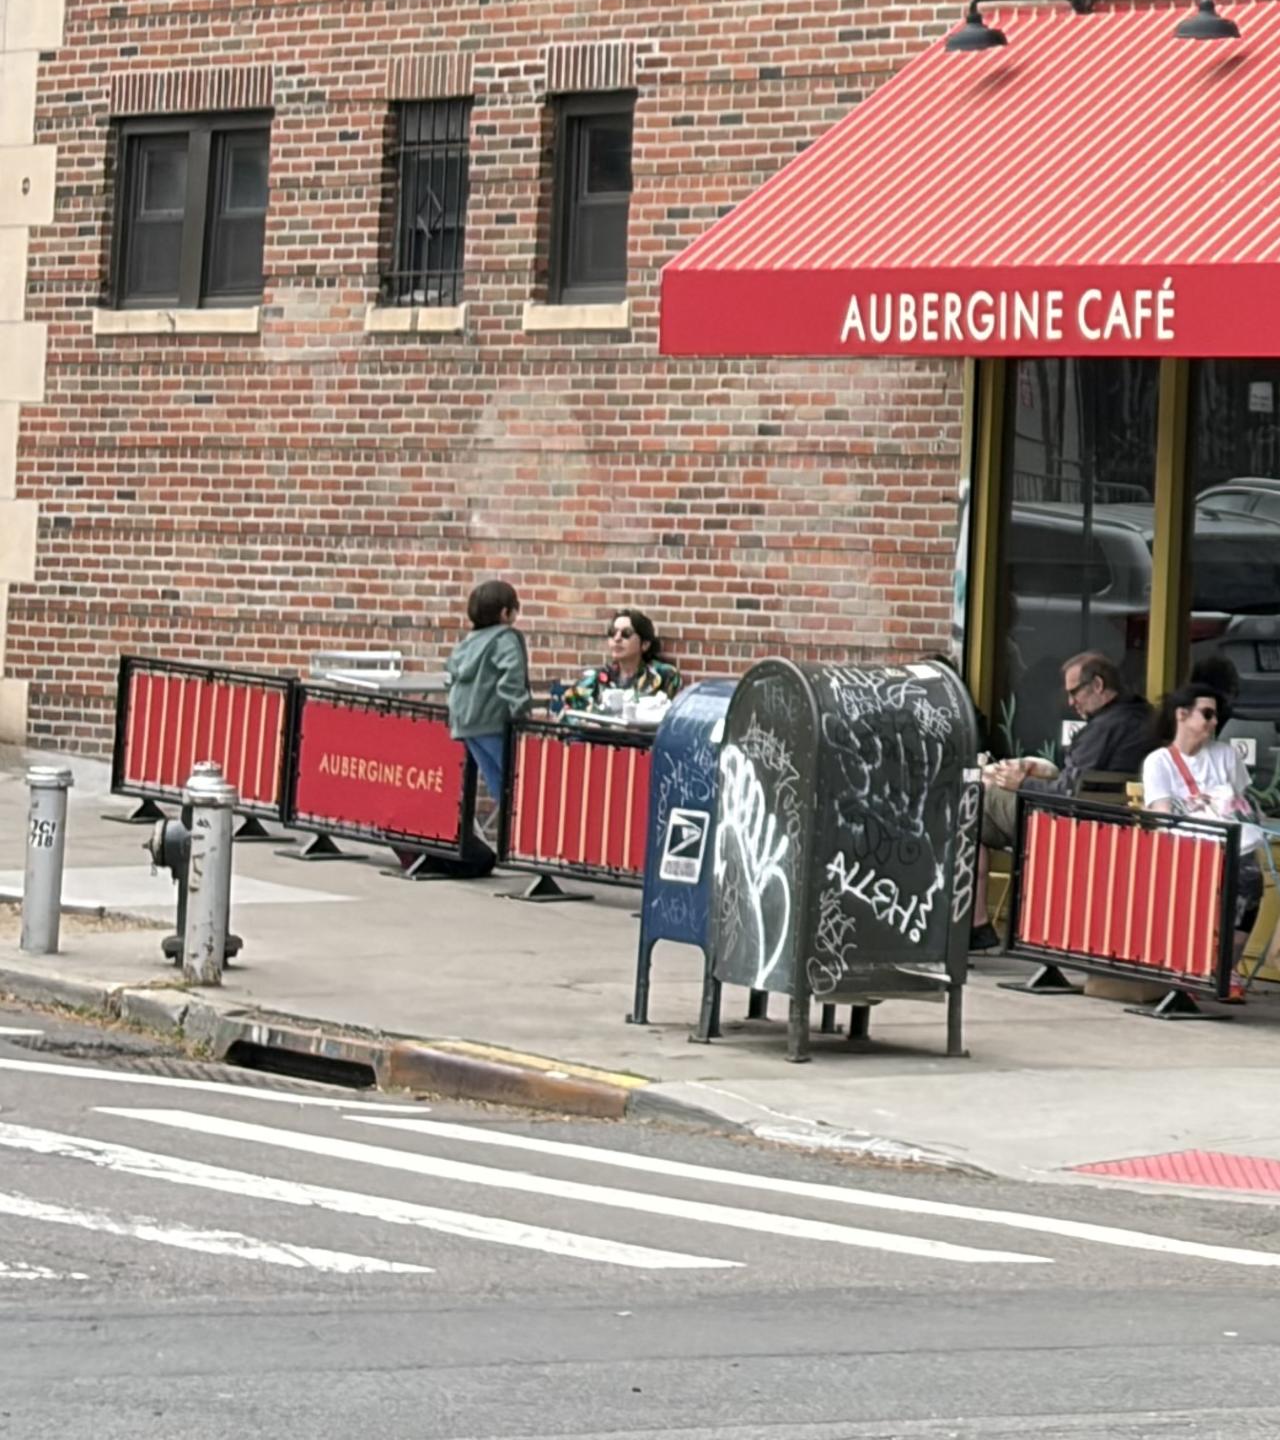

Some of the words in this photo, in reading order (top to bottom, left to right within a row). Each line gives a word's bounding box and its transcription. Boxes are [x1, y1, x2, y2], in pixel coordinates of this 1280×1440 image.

[840, 289, 1064, 343] AUBERGINE
[1077, 276, 1176, 341] CAFÉ
[318, 752, 404, 787] AUBERGINE
[406, 765, 444, 793] CAFÉ
